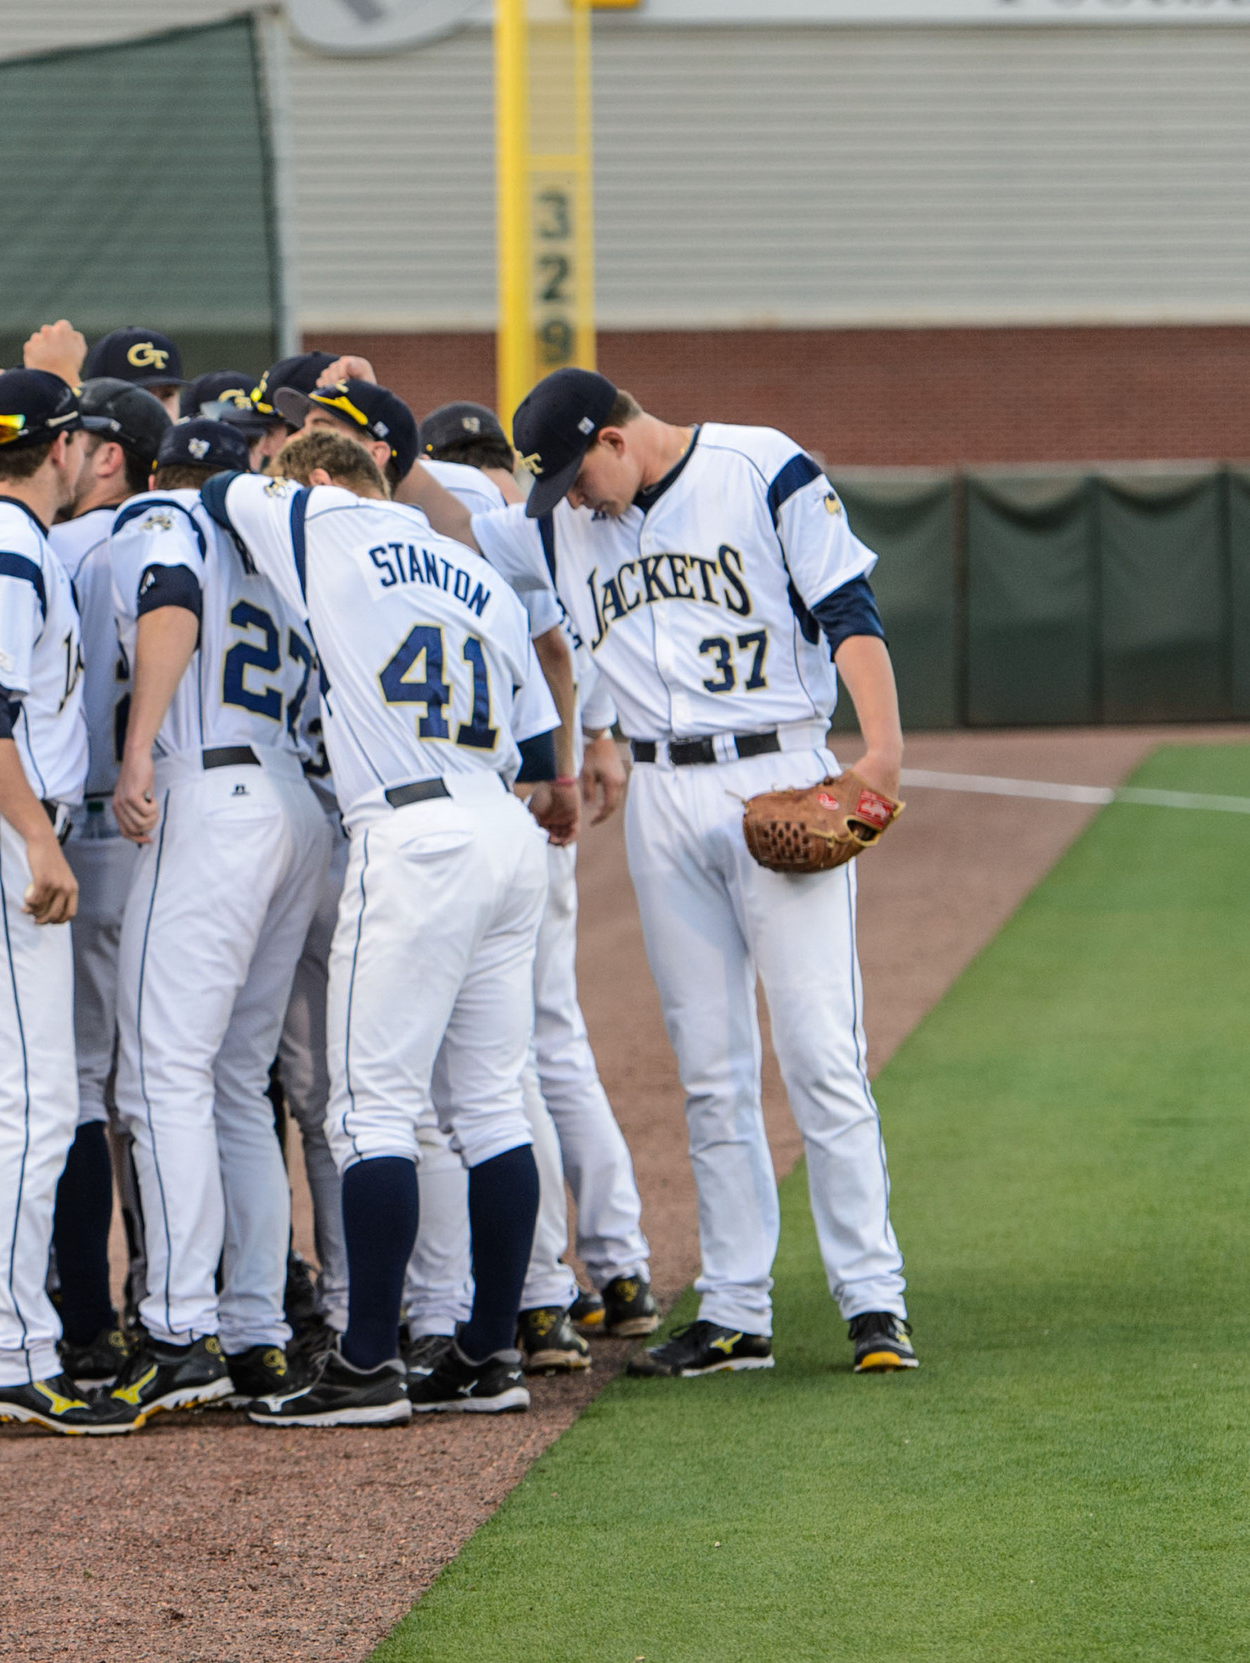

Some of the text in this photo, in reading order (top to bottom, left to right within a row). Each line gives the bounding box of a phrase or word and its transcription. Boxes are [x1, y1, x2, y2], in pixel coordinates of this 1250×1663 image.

[538, 187, 574, 366] 329
[127, 341, 169, 370] GT
[369, 542, 491, 618] STANTON
[587, 543, 753, 652] JACKETS
[376, 621, 500, 753] 41
[698, 628, 768, 695] 37
